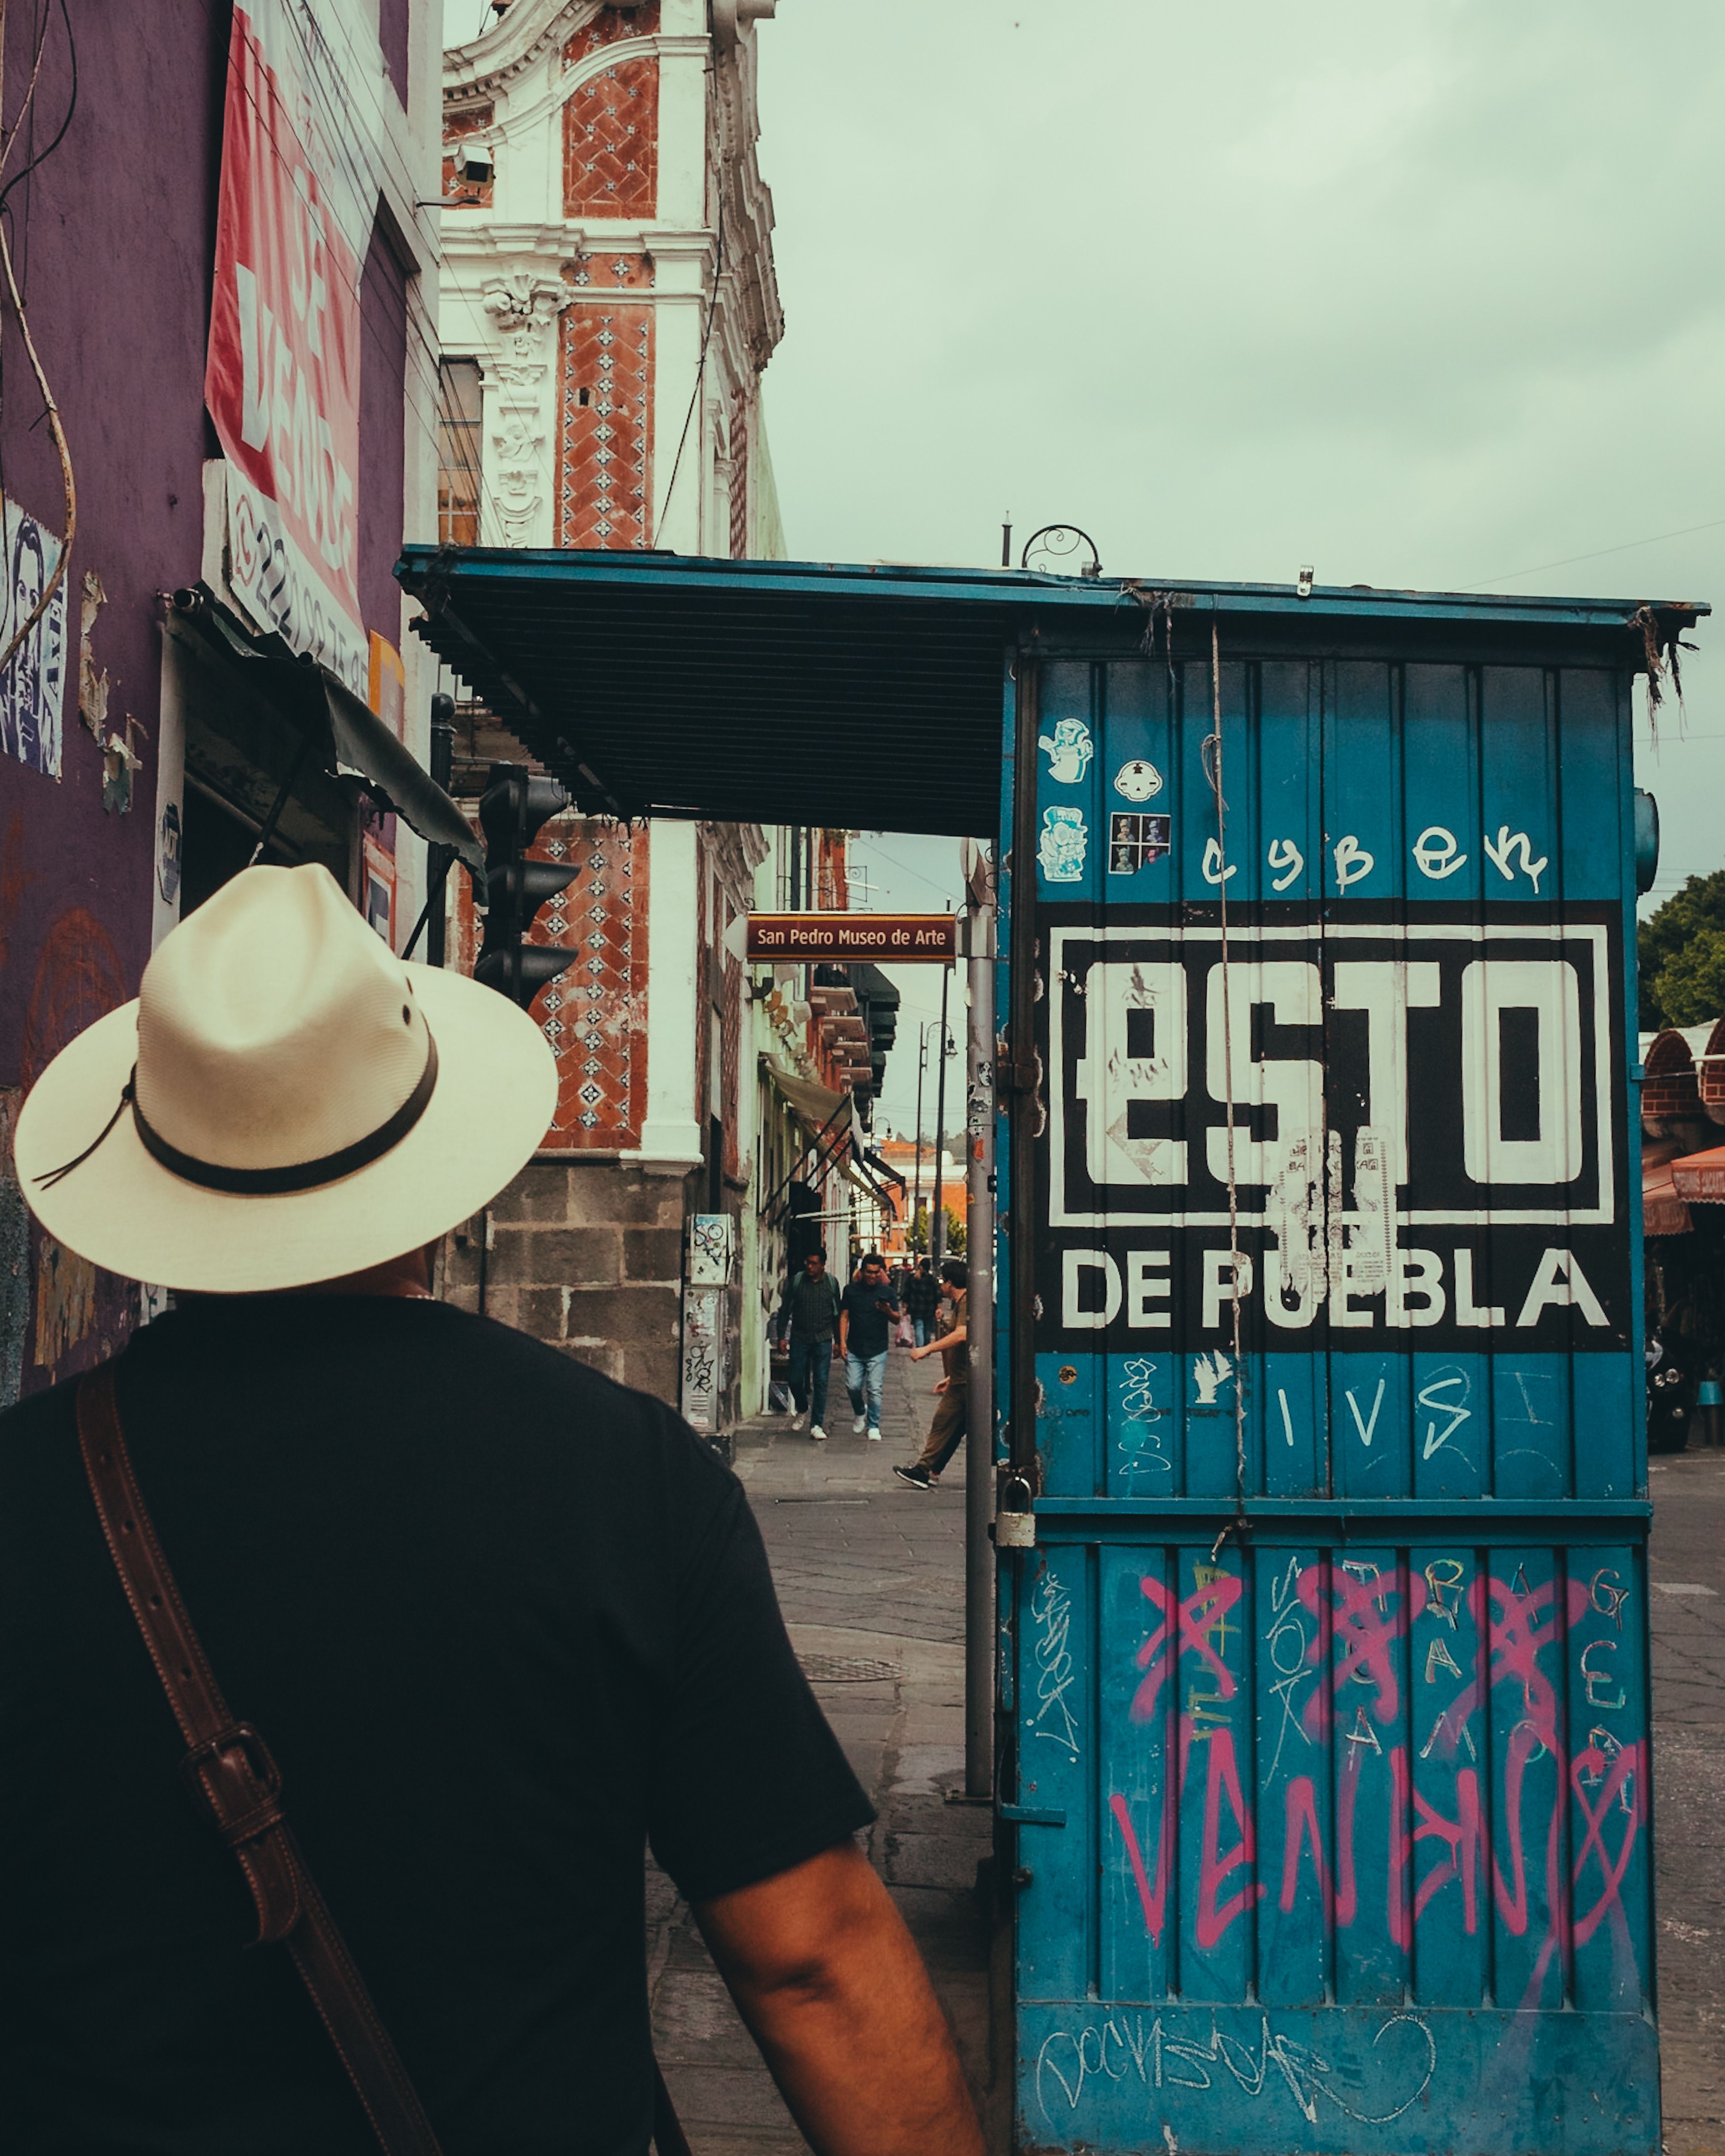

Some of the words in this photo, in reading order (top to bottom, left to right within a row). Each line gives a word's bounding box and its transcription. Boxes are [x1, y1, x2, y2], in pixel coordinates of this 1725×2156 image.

[758, 929, 785, 945] San
[790, 929, 834, 945] Pedro
[839, 929, 886, 945] Museo
[891, 929, 911, 945] de
[915, 929, 946, 945] Arte
[1062, 1249, 1171, 1329] DE
[1202, 1249, 1610, 1329] PUEBLA
